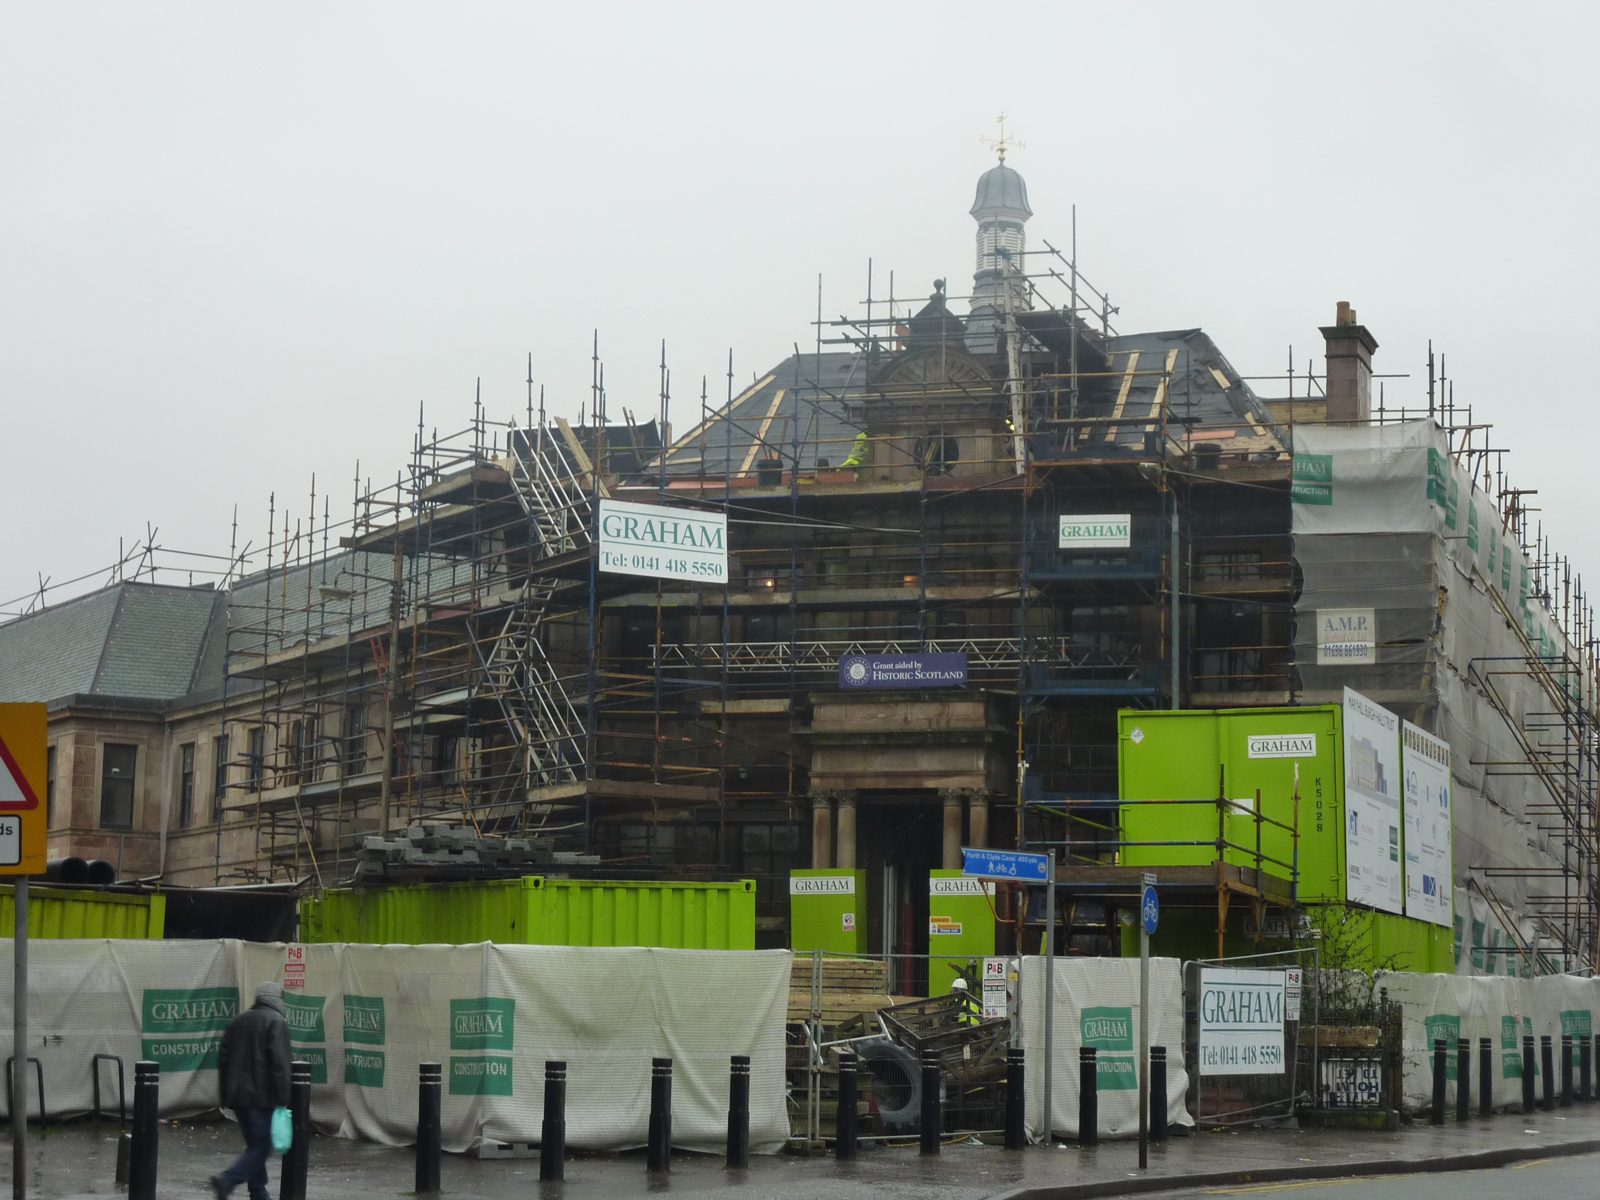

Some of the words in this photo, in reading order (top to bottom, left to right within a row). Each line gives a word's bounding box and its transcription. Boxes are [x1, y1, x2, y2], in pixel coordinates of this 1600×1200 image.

[1294, 461, 1326, 473] HAM
[602, 514, 724, 549] GRAHAM
[1061, 525, 1128, 537] GRAHAM
[602, 552, 628, 567] Tel:
[632, 555, 659, 571] 0141
[665, 559, 687, 573] 418
[692, 561, 723, 577] 5550
[1324, 616, 1367, 631] A.M.P.
[873, 662, 893, 670] Grant
[895, 661, 913, 669] aided
[914, 661, 923, 670] by
[873, 671, 913, 680] HISTORIC
[915, 670, 963, 680] SCOTLAND
[1251, 740, 1313, 752] GRAHAM
[795, 880, 849, 891] GRAHAM
[152, 1001, 235, 1020] GRAHAM
[1203, 990, 1282, 1023] GRAHAM
[455, 1014, 503, 1034] GRAHAM
[1084, 1021, 1128, 1038] GRAHAM
[1202, 1046, 1218, 1066] Tel:
[1220, 1045, 1238, 1065] 0141
[1241, 1045, 1257, 1065] 418
[1260, 1045, 1281, 1065] 5550
[454, 1062, 507, 1076] CONSTRUCTION
